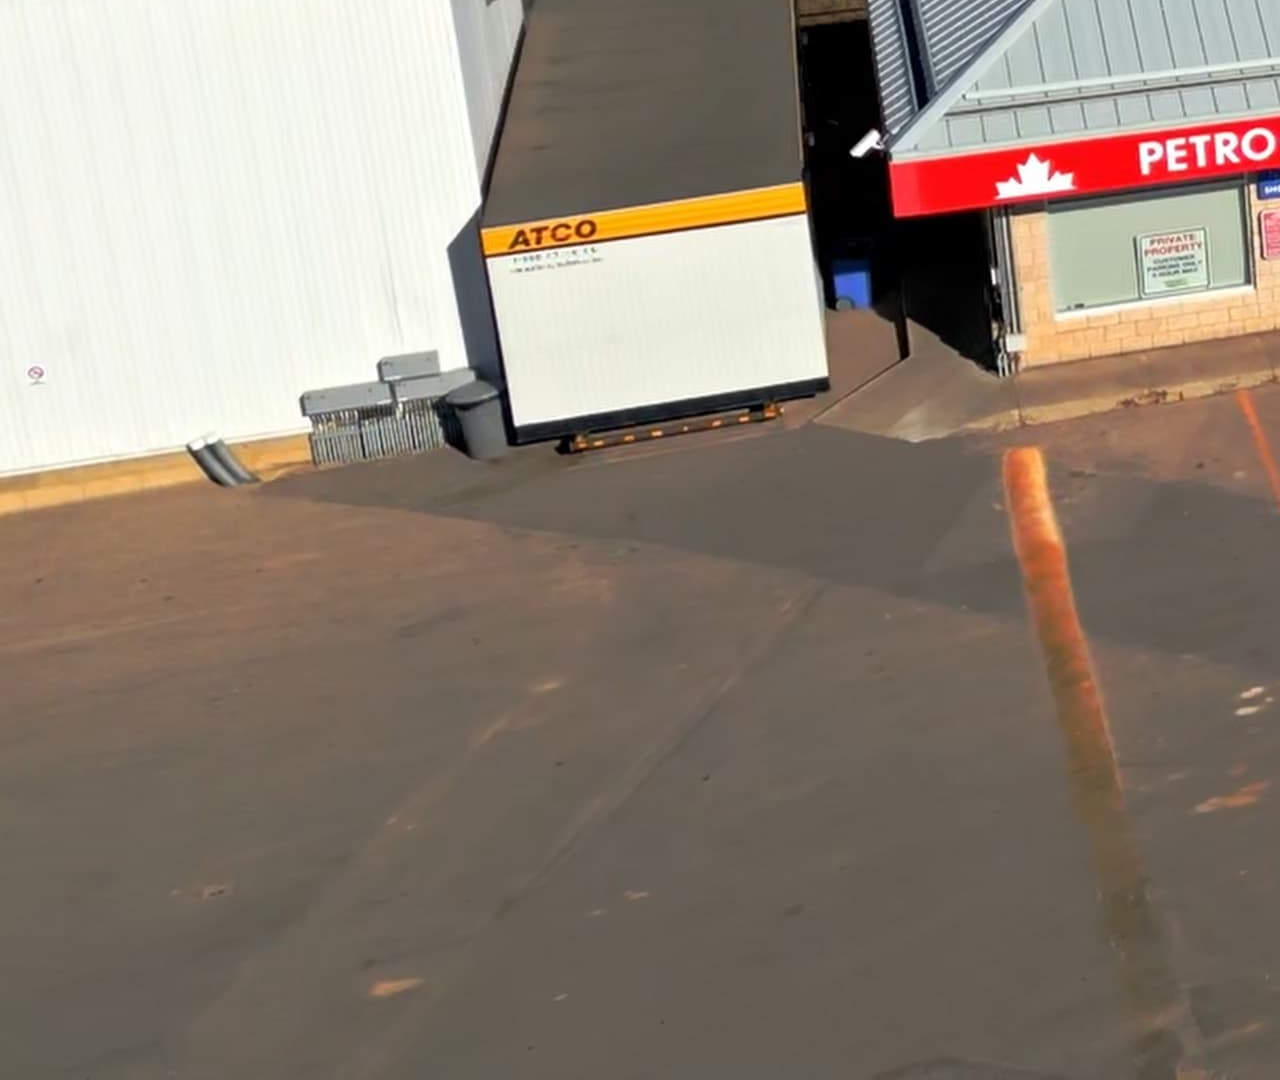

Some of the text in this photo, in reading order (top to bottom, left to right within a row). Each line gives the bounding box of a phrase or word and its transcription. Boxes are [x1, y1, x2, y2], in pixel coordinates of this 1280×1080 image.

[508, 220, 598, 250] ATCO
[1149, 233, 1196, 246] PRIVATE
[1144, 242, 1202, 257] PROPERTY
